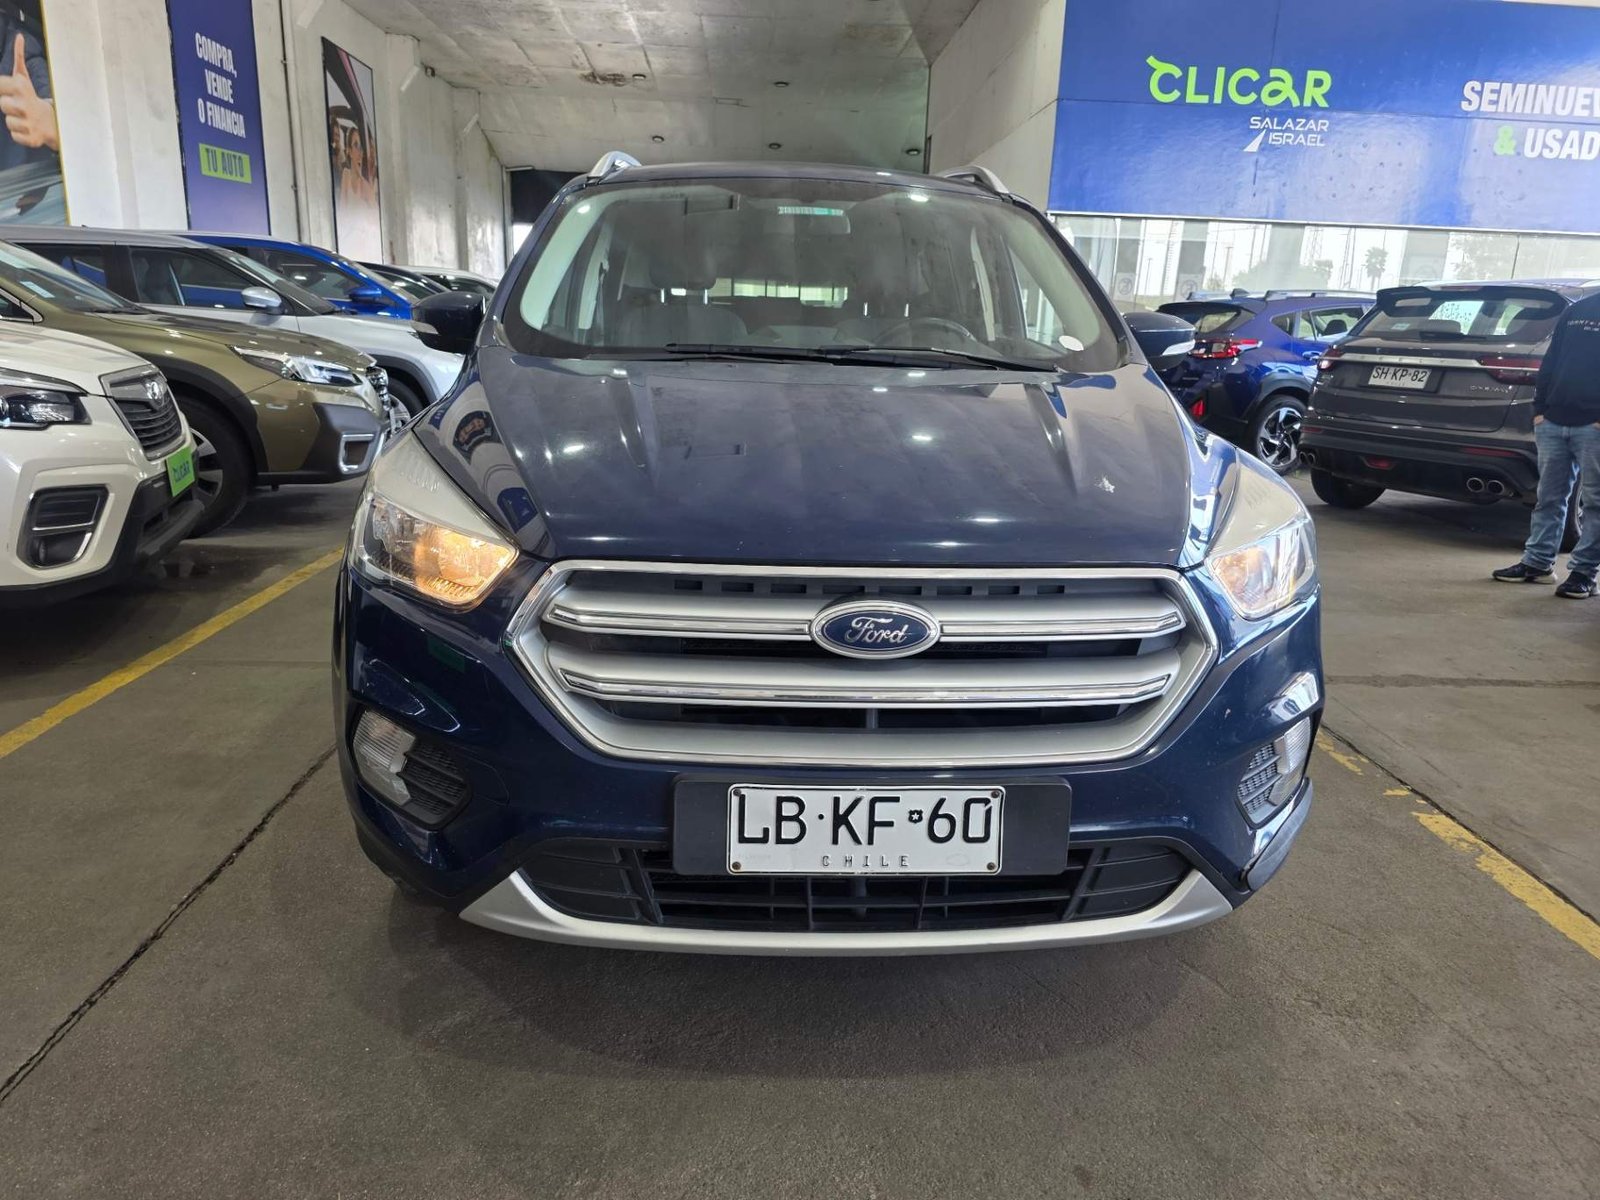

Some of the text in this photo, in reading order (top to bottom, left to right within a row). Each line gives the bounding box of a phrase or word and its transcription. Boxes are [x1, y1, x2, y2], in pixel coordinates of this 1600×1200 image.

[195, 32, 237, 78] COMPRA,
[205, 69, 234, 104] VENDE
[197, 98, 246, 138] O FINANCIA
[1249, 116, 1329, 131] SALAZAR
[1268, 132, 1325, 147] ISRAEL
[1493, 125, 1517, 155] &
[205, 148, 245, 178] TU AUTO
[845, 616, 909, 643] Ford
